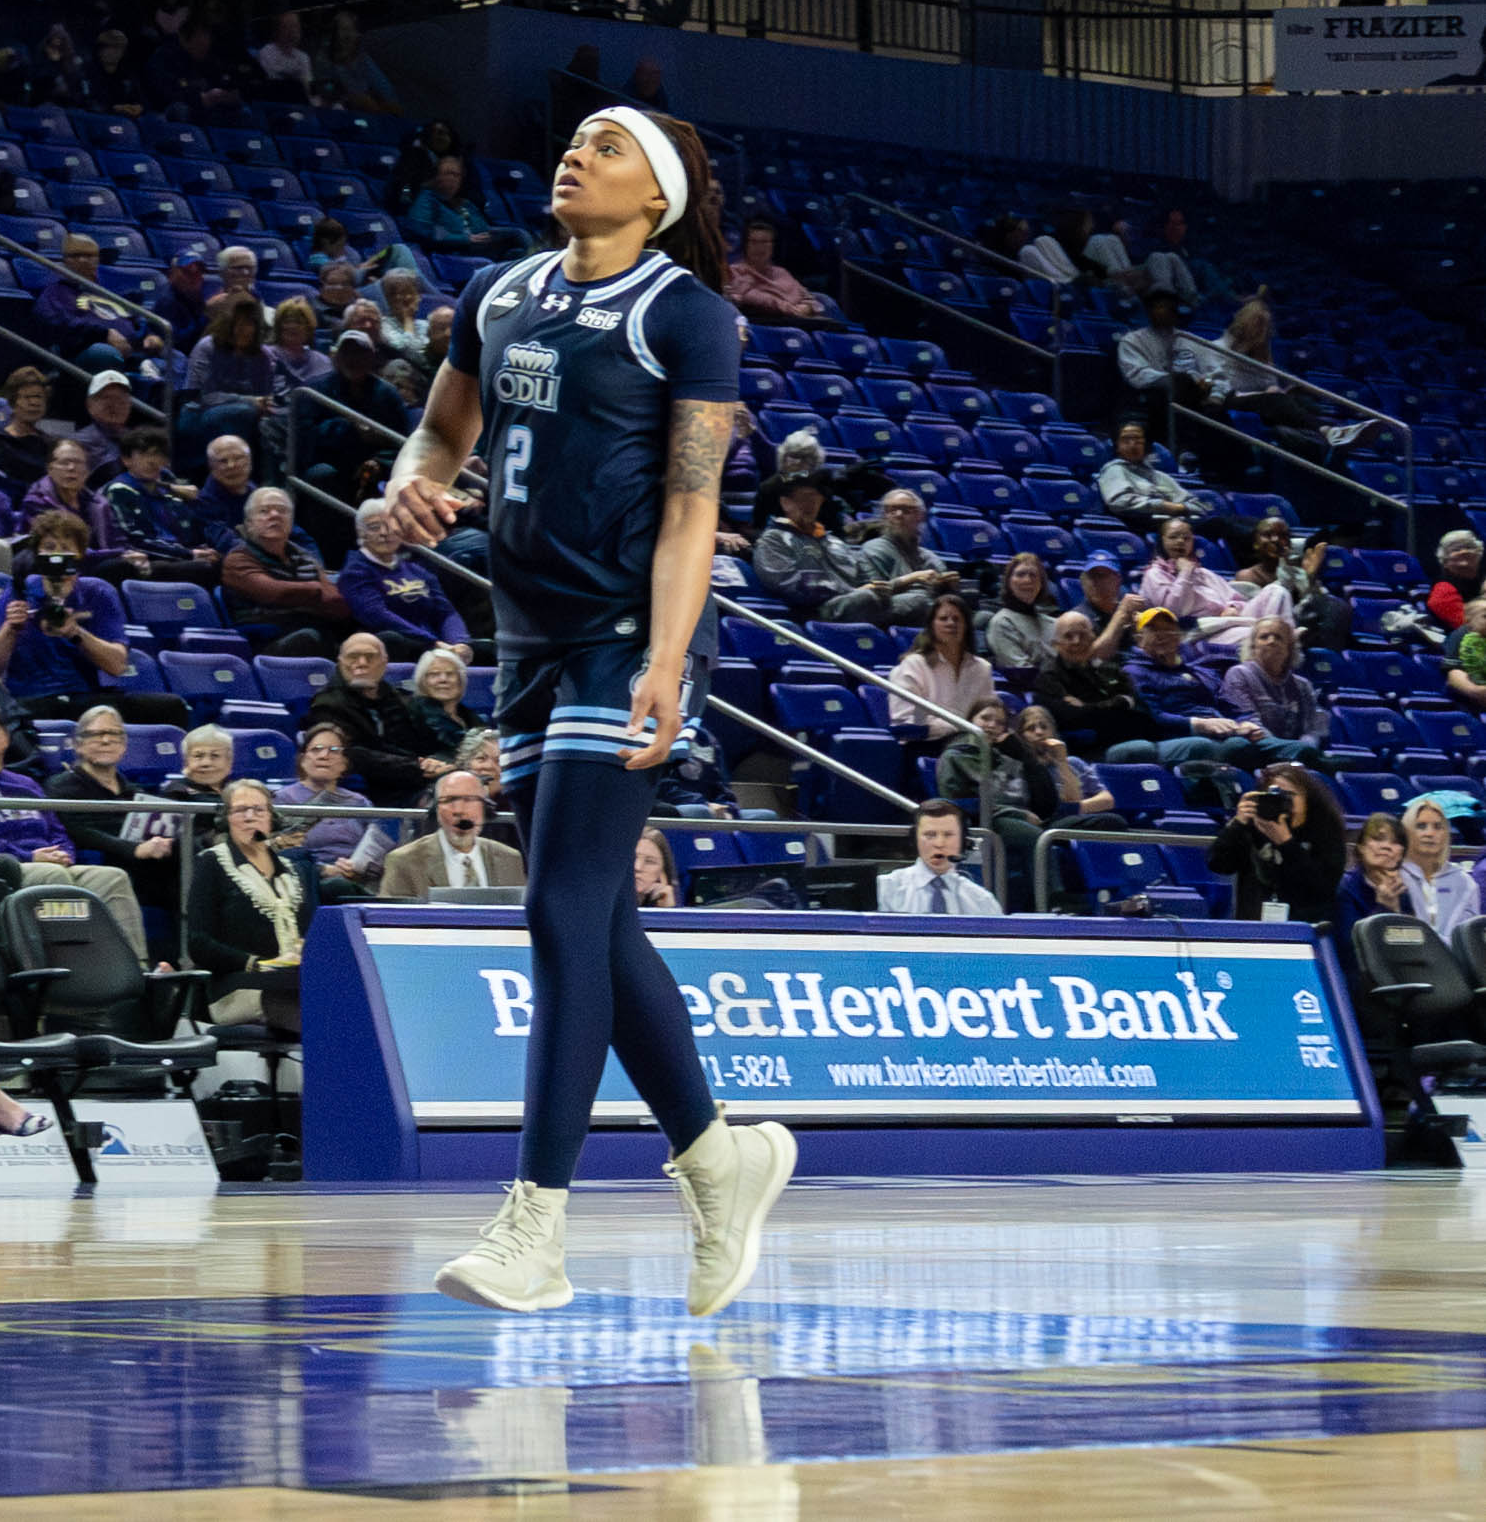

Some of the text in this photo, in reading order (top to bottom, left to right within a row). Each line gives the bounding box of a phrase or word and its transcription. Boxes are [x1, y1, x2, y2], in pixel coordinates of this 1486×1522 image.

[1323, 15, 1466, 39] FRAZIER
[492, 372, 563, 413] ODU
[502, 424, 534, 504] 2
[1049, 971, 1239, 1041] Bank
[701, 1054, 1157, 1088] 1-5824 www.burkeandherbertbank.com
